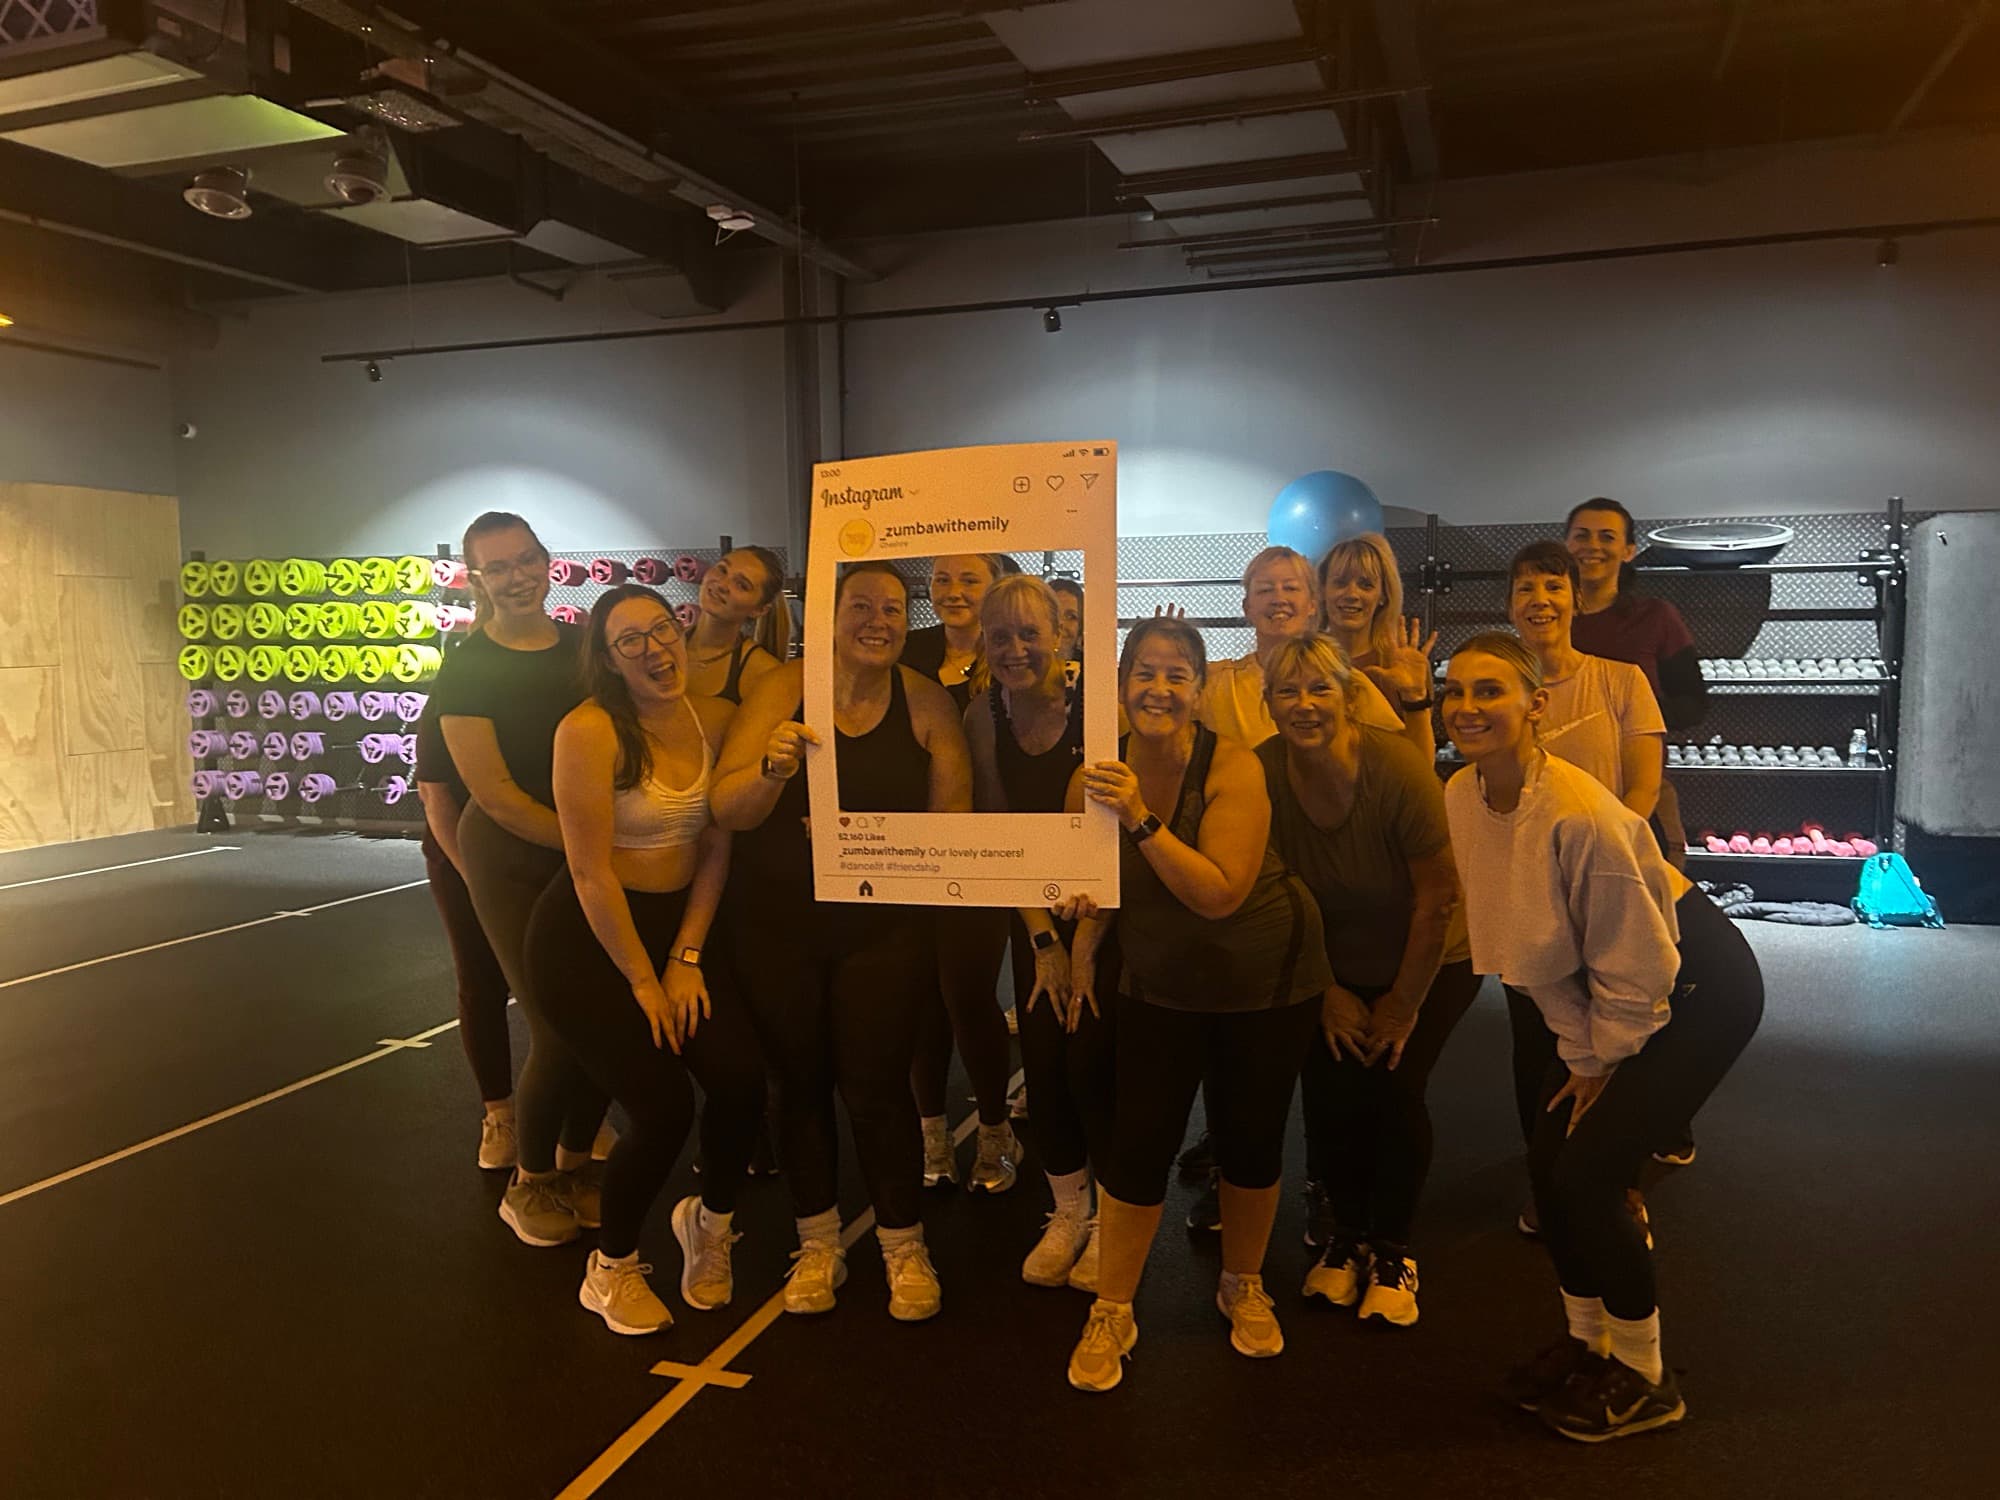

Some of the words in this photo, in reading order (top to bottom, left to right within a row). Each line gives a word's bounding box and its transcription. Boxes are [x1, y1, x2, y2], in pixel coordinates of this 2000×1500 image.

[820, 486, 904, 511] Instagram
[879, 516, 1010, 541] _zumbawithemily
[865, 833, 886, 841] Likes
[838, 846, 926, 858] _zumbawithemily
[928, 847, 947, 857] Our
[949, 847, 978, 859] lovely
[980, 848, 1025, 858] dancers!
[887, 862, 941, 873] #friendship
